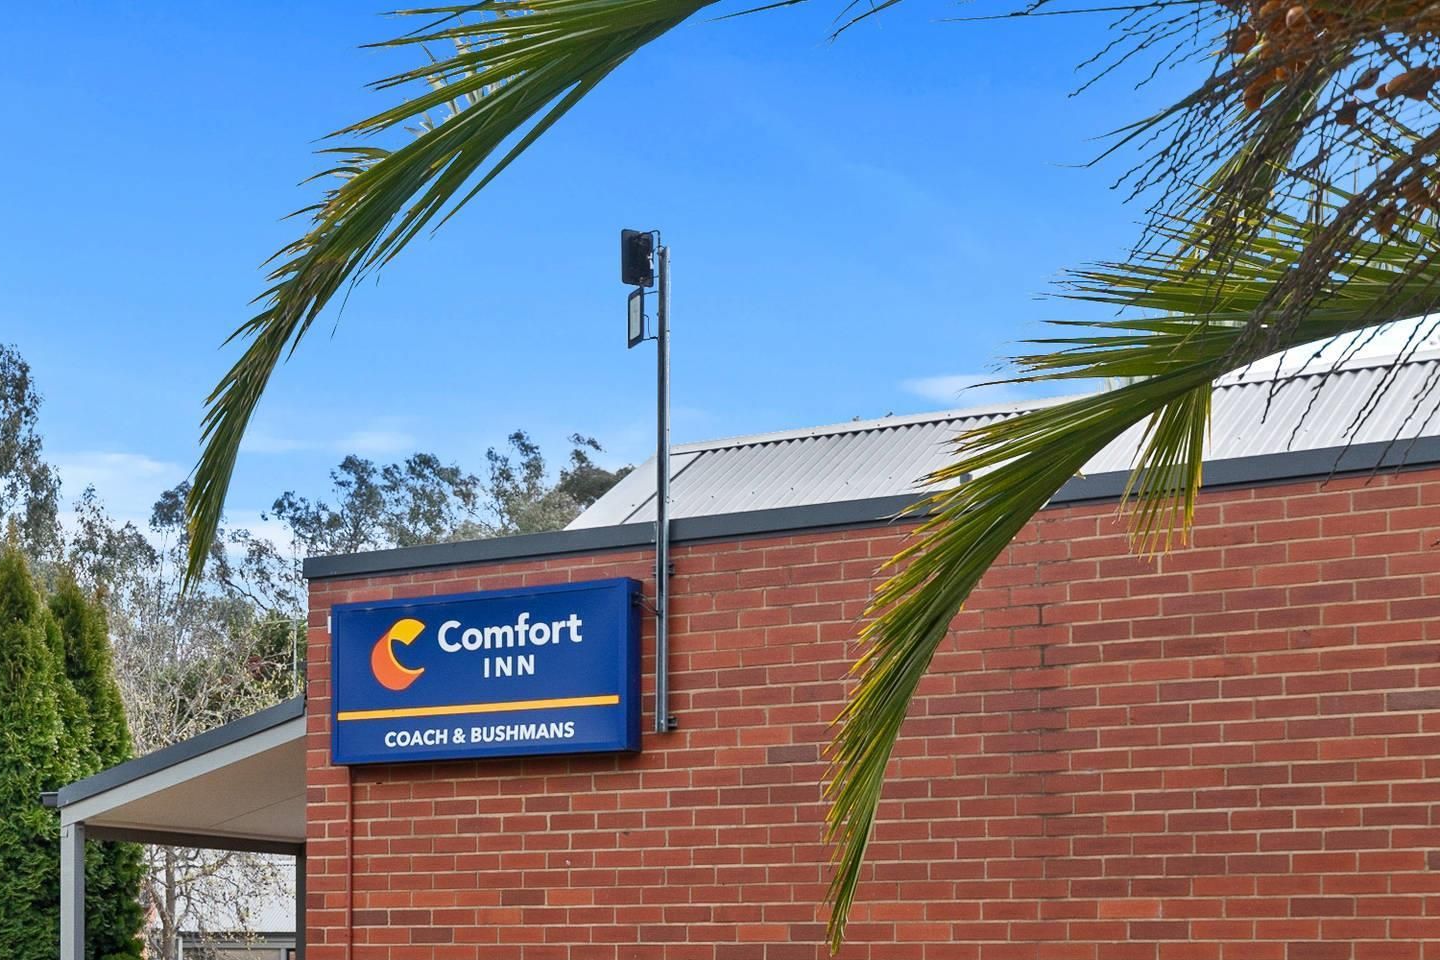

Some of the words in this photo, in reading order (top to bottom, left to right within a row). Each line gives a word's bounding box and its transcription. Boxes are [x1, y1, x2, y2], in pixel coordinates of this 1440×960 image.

[437, 611, 583, 653] Comfort
[483, 654, 535, 679] INN
[384, 728, 449, 748] COACH
[451, 728, 467, 745] &
[470, 720, 576, 744] BUSHMANS
